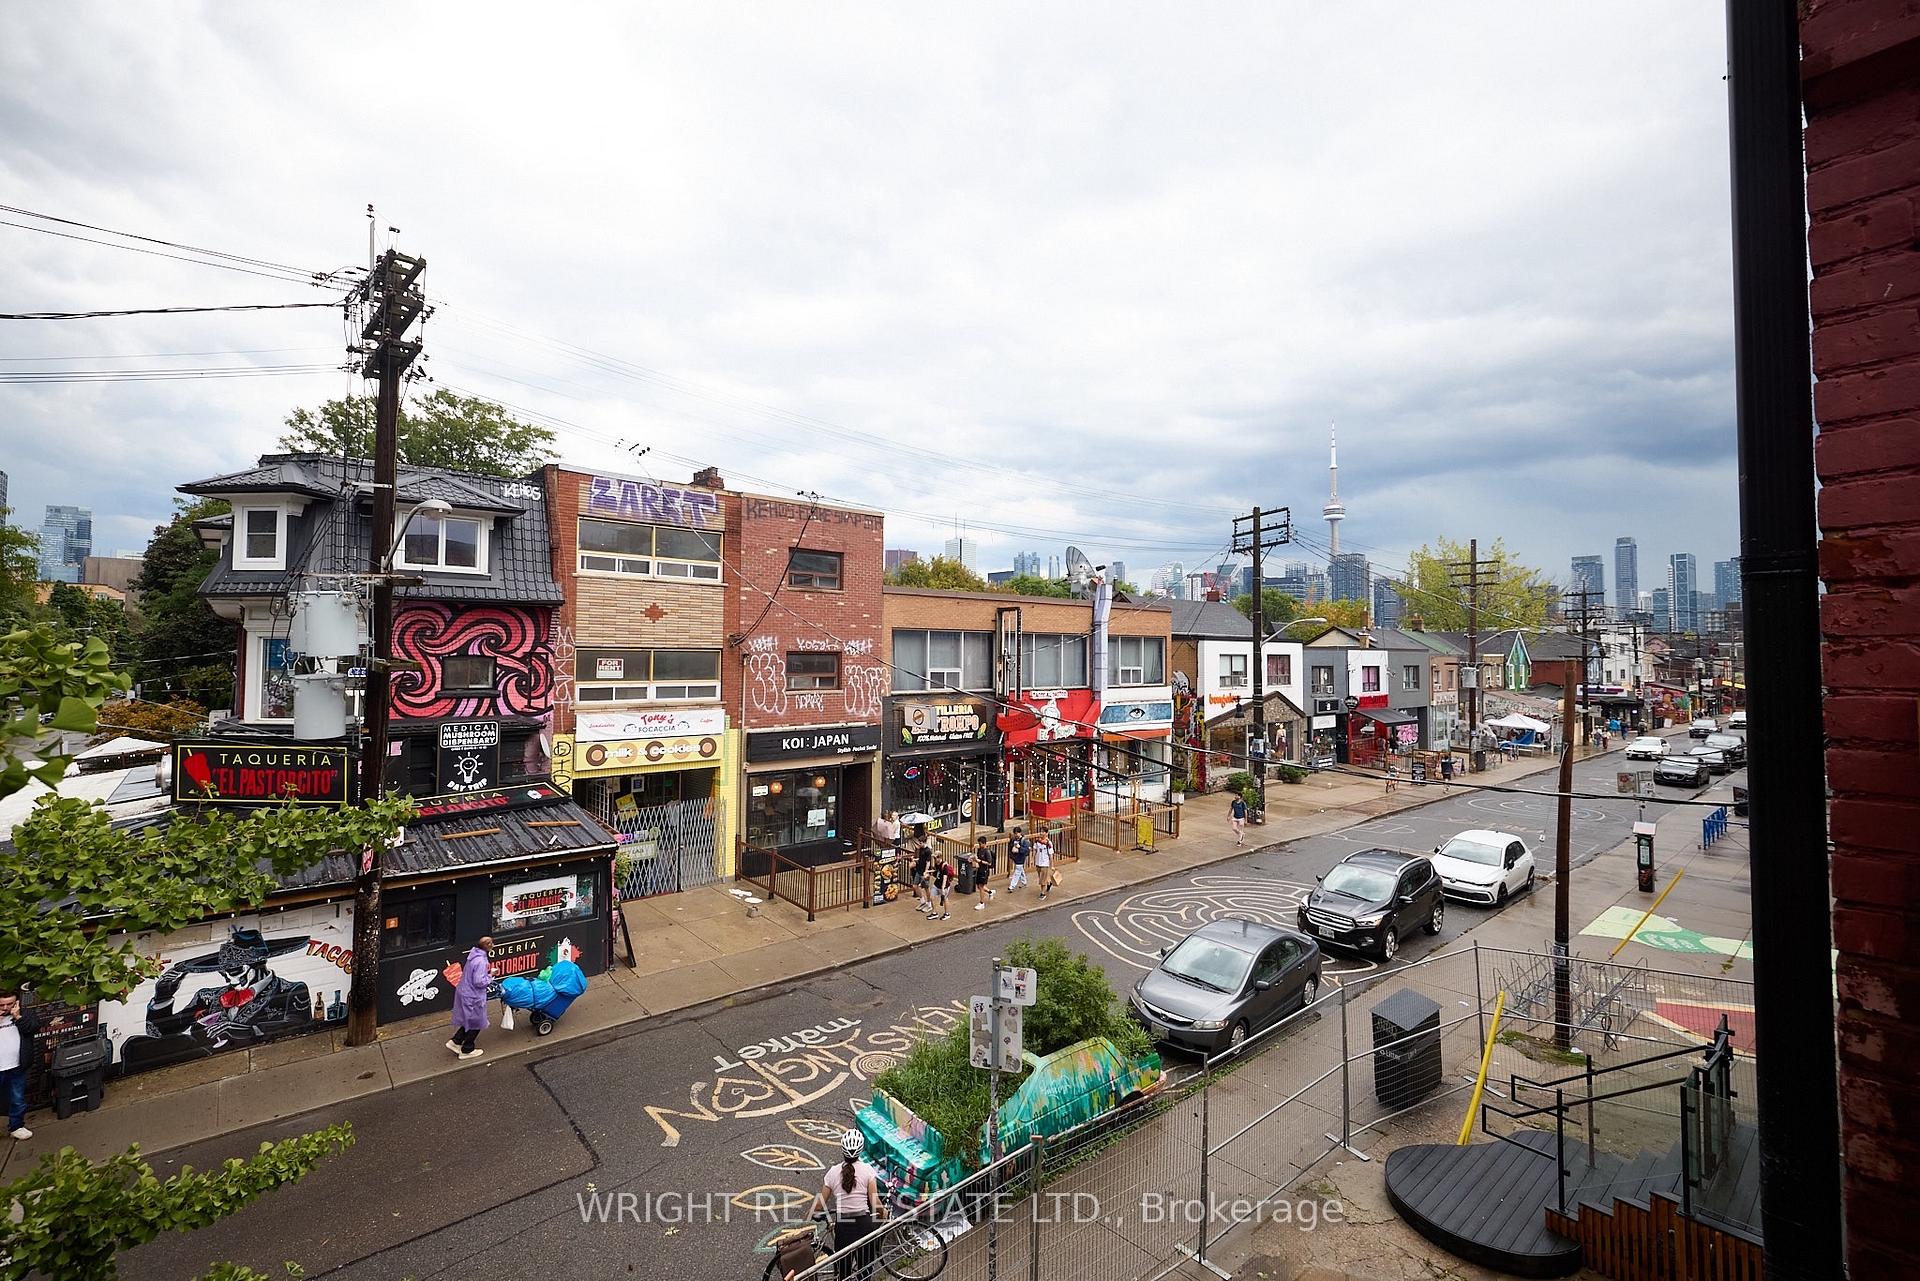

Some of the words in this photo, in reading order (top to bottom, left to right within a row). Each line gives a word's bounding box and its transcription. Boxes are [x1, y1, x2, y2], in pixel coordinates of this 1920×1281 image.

[443, 724, 496, 733] MEDICAL
[443, 730, 496, 739] MUSHROOM
[638, 725, 676, 733] FOCACCIA
[811, 733, 850, 749] JAPAN
[219, 751, 332, 766] TAQUERÍA
[604, 748, 633, 759] milk
[639, 748, 648, 756] &
[650, 744, 701, 757] cookies
[447, 780, 467, 792] DAY
[467, 777, 488, 791] TRIP
[488, 941, 537, 958] QUERÍA
